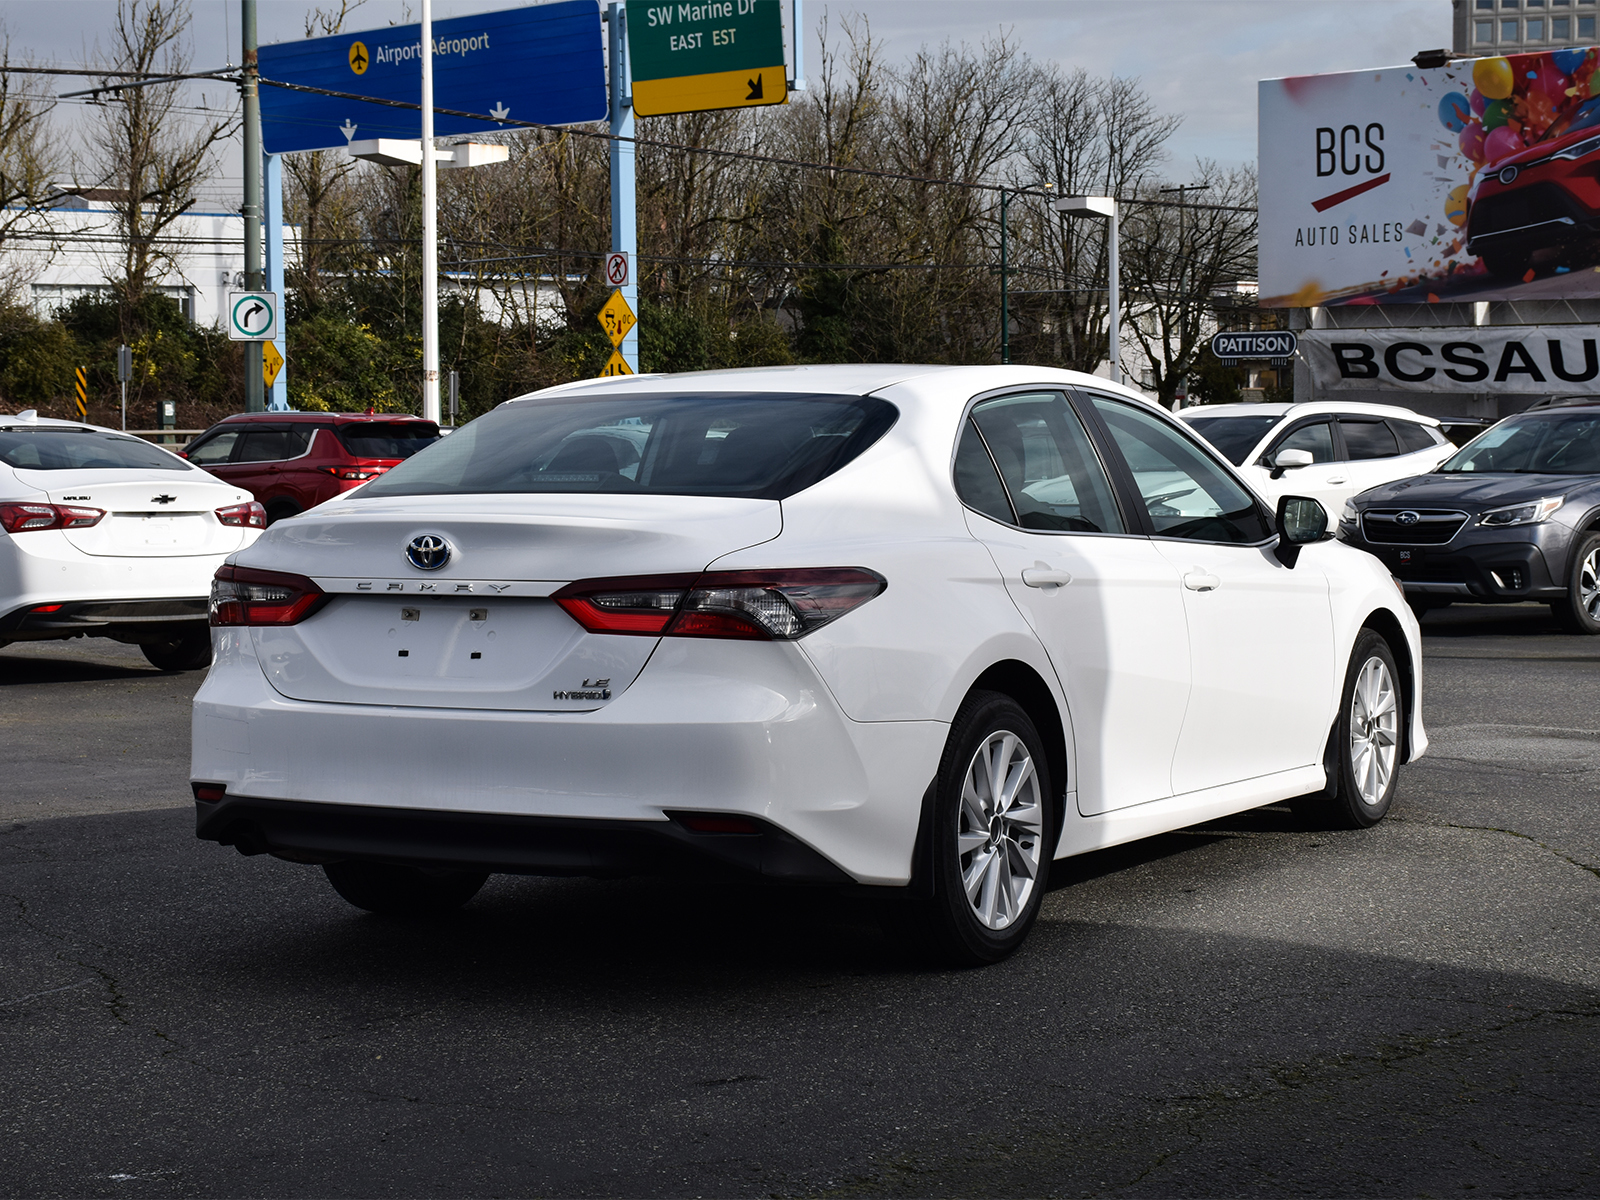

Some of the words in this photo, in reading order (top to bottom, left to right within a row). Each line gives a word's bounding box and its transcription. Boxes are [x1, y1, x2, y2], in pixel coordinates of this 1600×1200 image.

[647, 6, 673, 27] SW
[678, 0, 733, 23] Marine
[738, 0, 757, 15] Dr
[376, 41, 423, 66] Airport
[431, 32, 490, 57] Aéroport
[670, 32, 703, 51] EAST
[712, 28, 737, 46] EST
[1316, 122, 1385, 177] BCS
[1295, 225, 1339, 247] AUTO
[1348, 222, 1403, 244] SALES
[1219, 336, 1290, 352] PATTISON
[1330, 338, 1600, 383] BCSAU
[1400, 550, 1411, 559] BCS
[356, 582, 511, 593] CAMRY
[581, 678, 611, 688] LE
[553, 690, 603, 700] HYBRID
